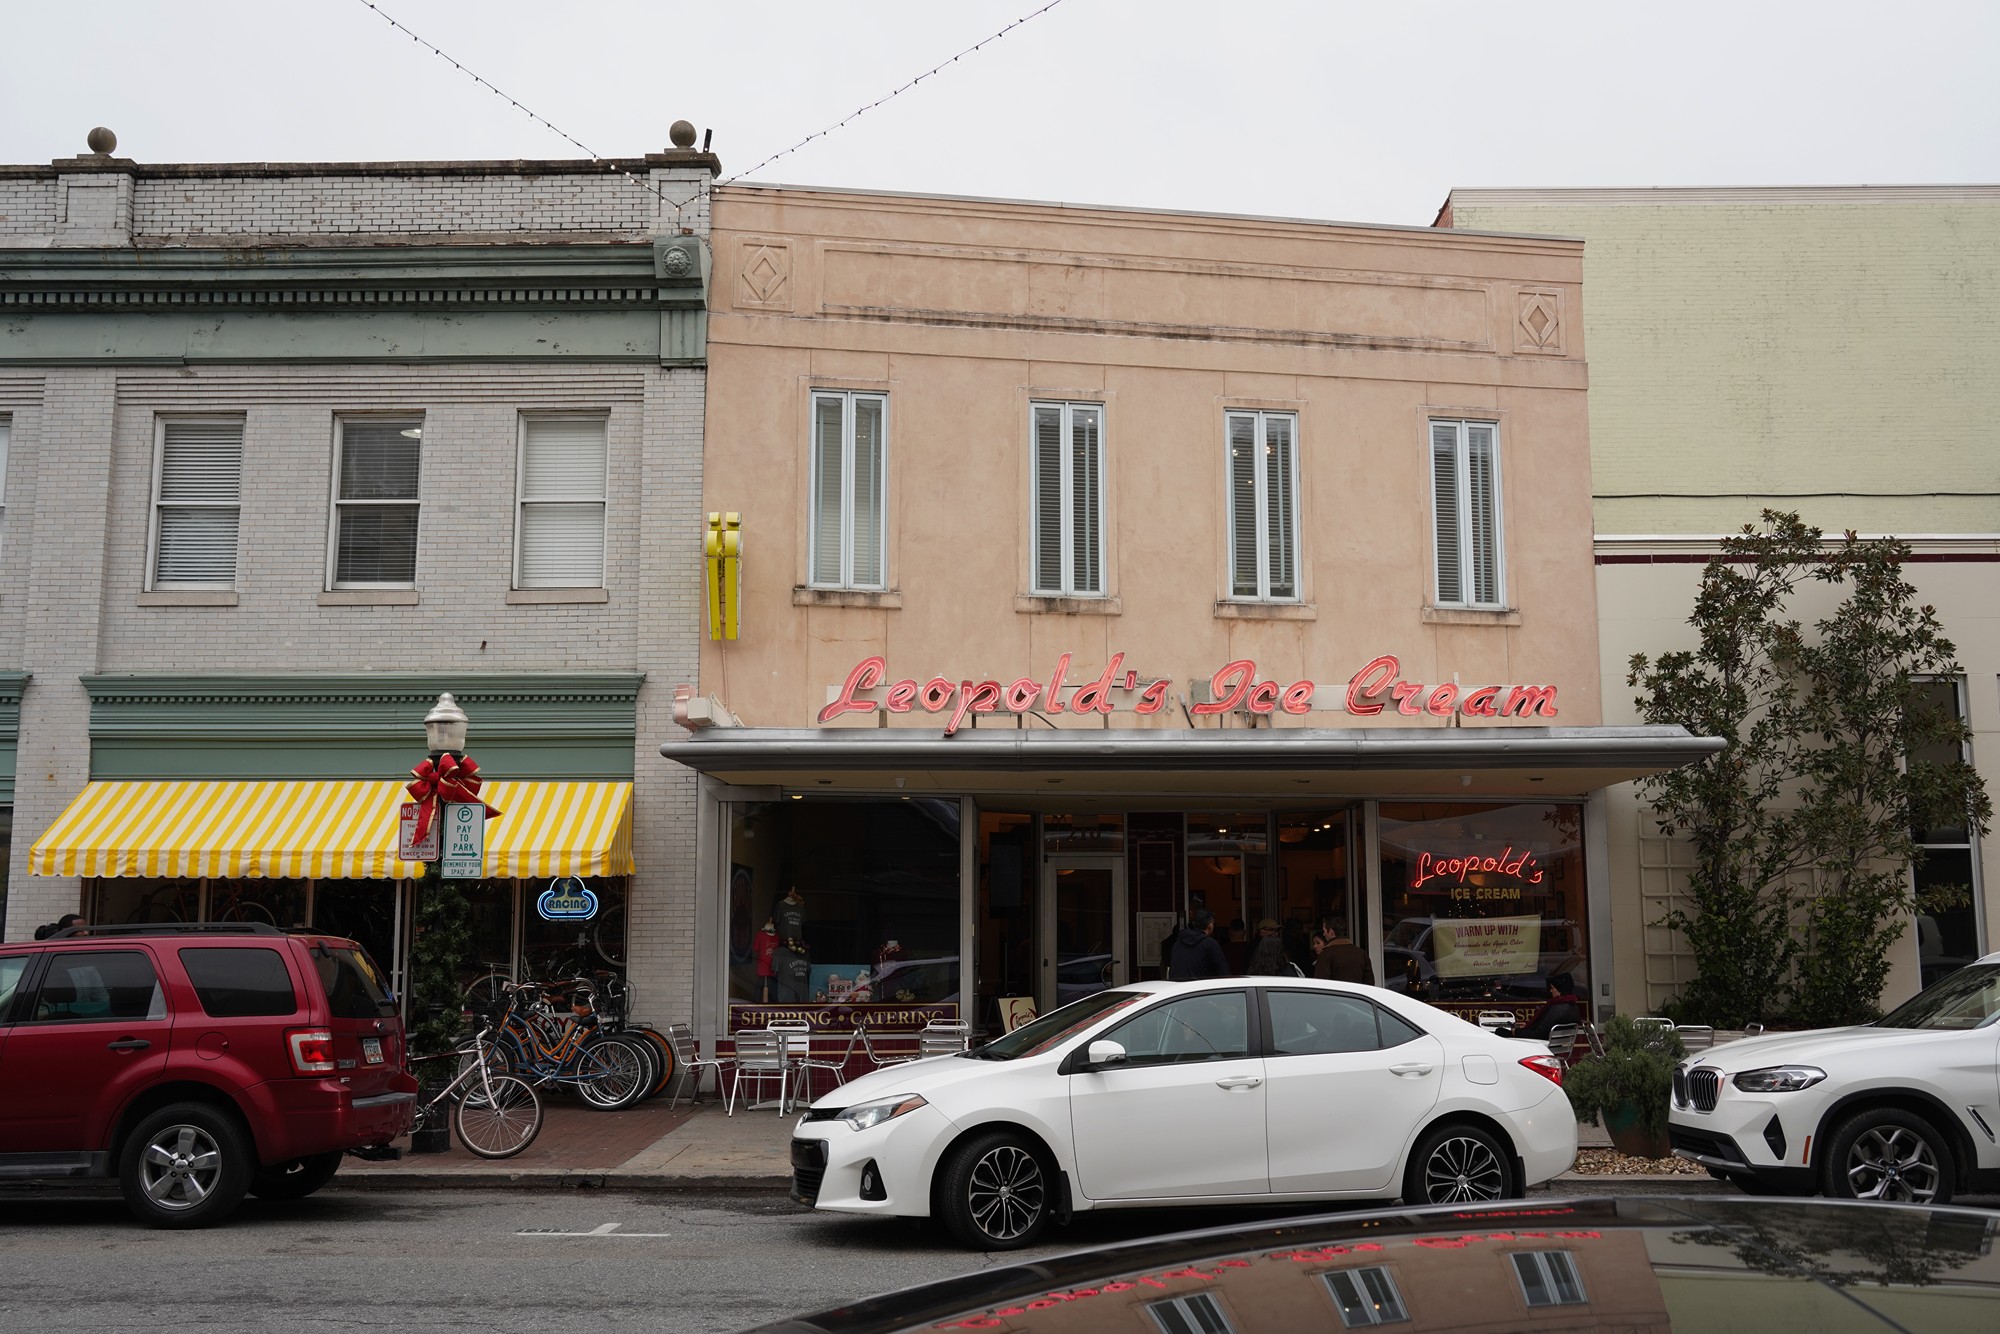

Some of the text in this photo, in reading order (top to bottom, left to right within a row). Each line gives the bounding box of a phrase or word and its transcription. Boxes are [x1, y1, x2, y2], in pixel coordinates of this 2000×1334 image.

[817, 651, 1559, 738] Leopold's Ice Cream
[402, 807, 412, 817] NO
[456, 825, 472, 833] PAY
[453, 843, 474, 851] PARK
[1412, 846, 1544, 888] Leopold's
[1450, 888, 1521, 900] ICE CREAM
[549, 899, 587, 909] RACING
[1456, 924, 1519, 938] WARM UP WITH
[741, 1011, 832, 1026] SHIPPING
